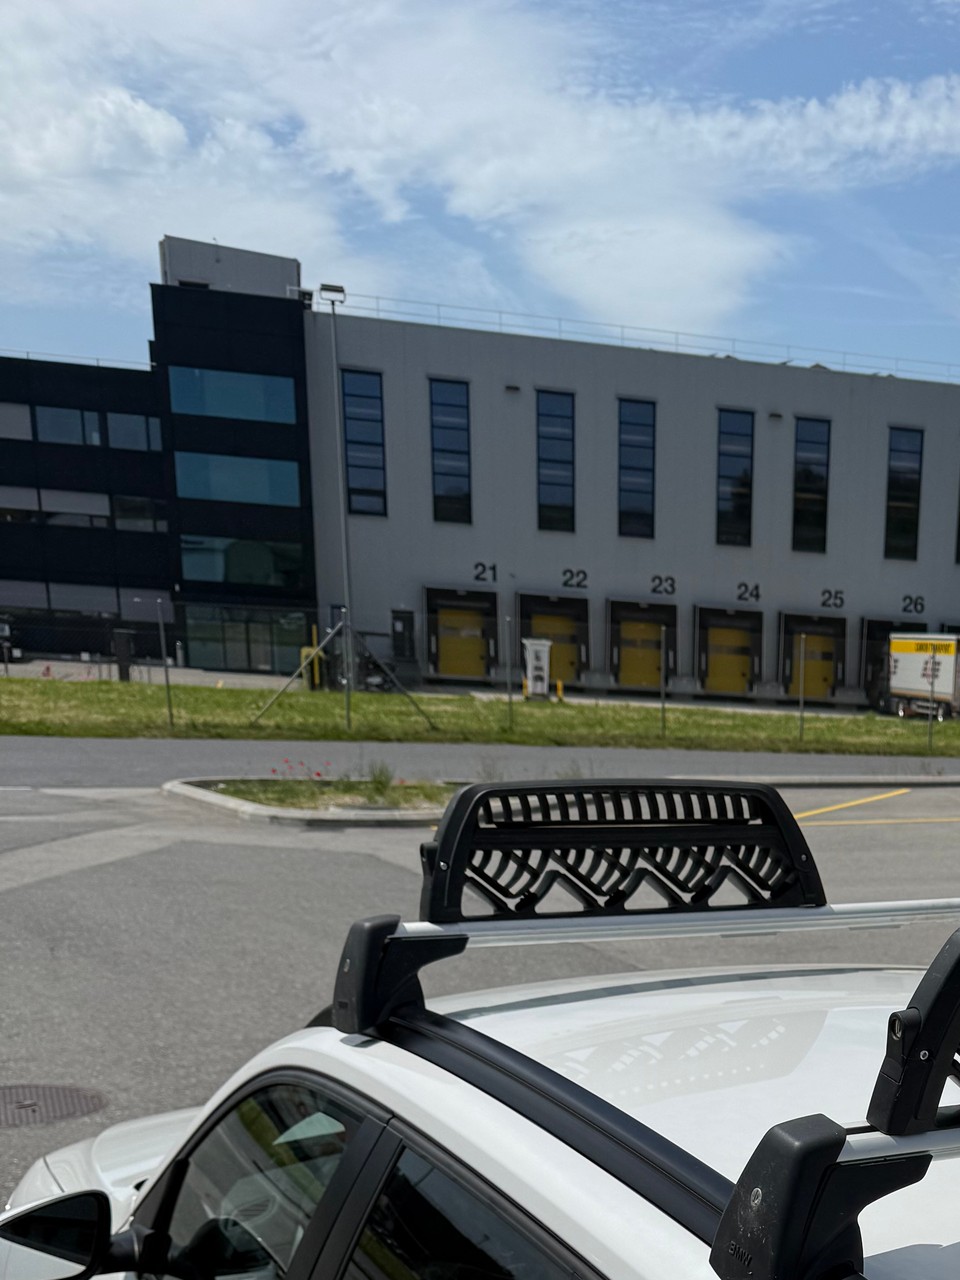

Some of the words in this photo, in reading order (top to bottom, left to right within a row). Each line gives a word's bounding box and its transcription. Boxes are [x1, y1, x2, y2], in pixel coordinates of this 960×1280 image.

[474, 562, 498, 582] 21
[562, 569, 588, 589] 22
[651, 575, 677, 595] 23
[737, 582, 760, 602] 24
[821, 589, 845, 608] 25
[902, 595, 925, 614] 26
[729, 1240, 752, 1267] BMW
